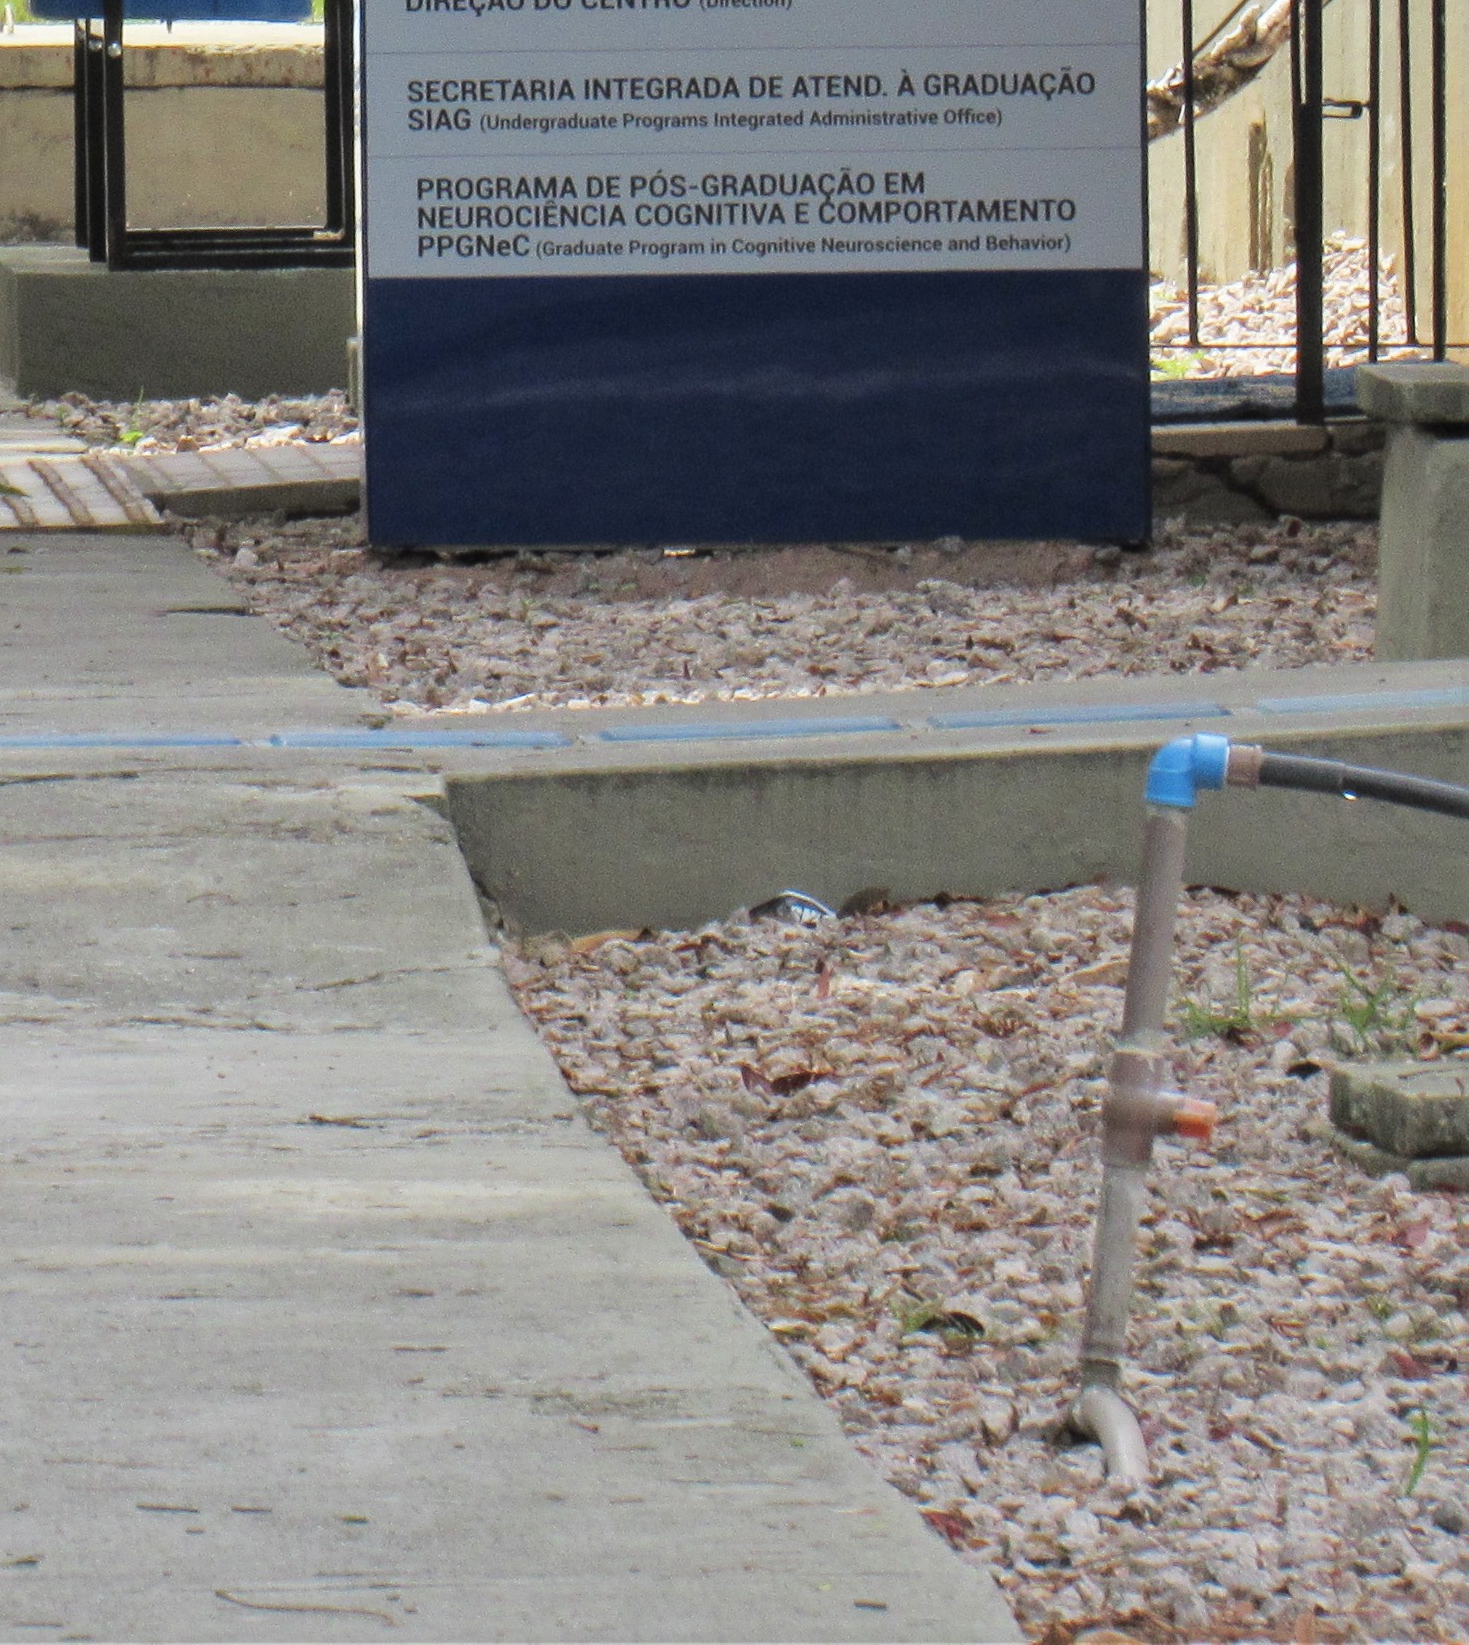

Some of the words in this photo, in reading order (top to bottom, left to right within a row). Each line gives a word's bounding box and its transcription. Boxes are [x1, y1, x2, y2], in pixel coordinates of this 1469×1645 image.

[407, 78, 575, 104] SECRETARIA
[584, 76, 740, 101] INTEGRADA
[748, 75, 783, 100] DE
[792, 74, 888, 99] ATEND.
[897, 68, 916, 97] À
[923, 69, 1096, 101] GRADUAÇÃO
[408, 106, 472, 133] SIAG
[479, 112, 618, 135] (Undergraduate
[622, 111, 709, 133] Programs
[713, 108, 805, 132] Integrated
[809, 109, 939, 127] Administrative
[943, 106, 1003, 128] Office)
[417, 176, 578, 205] PROGRAMA
[586, 175, 620, 199] DE
[630, 171, 876, 203] PÓS-GRADUAÇÃO
[884, 171, 925, 196] EM
[417, 199, 626, 230] NEUROCIÊNCIA
[635, 201, 786, 227] COGNITIVA
[794, 201, 809, 225] E
[818, 197, 1077, 226] COMPORTAMENTO
[417, 232, 530, 259] PPGNeC
[536, 239, 624, 258] (Graduate
[628, 238, 705, 259] Program
[710, 241, 727, 255] in
[731, 238, 816, 258] Cognitive
[821, 236, 943, 254] Neuroscience
[947, 234, 981, 253] and
[985, 232, 1072, 254] Behavior)
